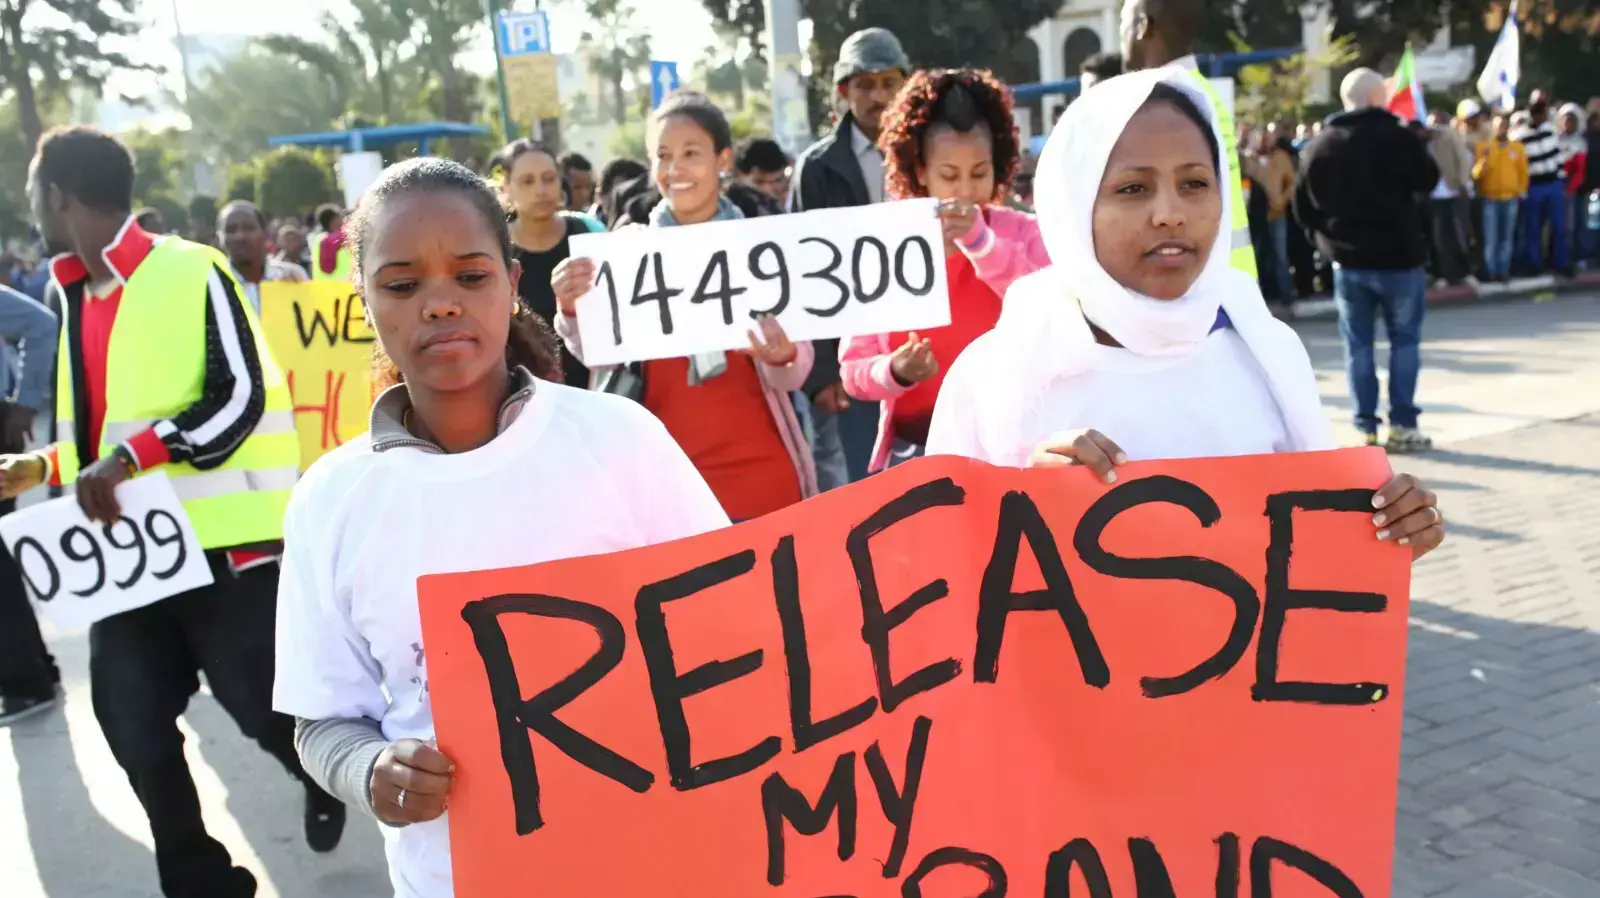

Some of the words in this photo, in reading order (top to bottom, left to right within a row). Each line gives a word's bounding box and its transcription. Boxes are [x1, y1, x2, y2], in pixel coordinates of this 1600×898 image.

[293, 293, 377, 348] WE
[595, 235, 935, 346] 1449300
[14, 509, 187, 602] 0999
[461, 475, 1389, 836] RELEASE
[762, 716, 932, 886] MY
